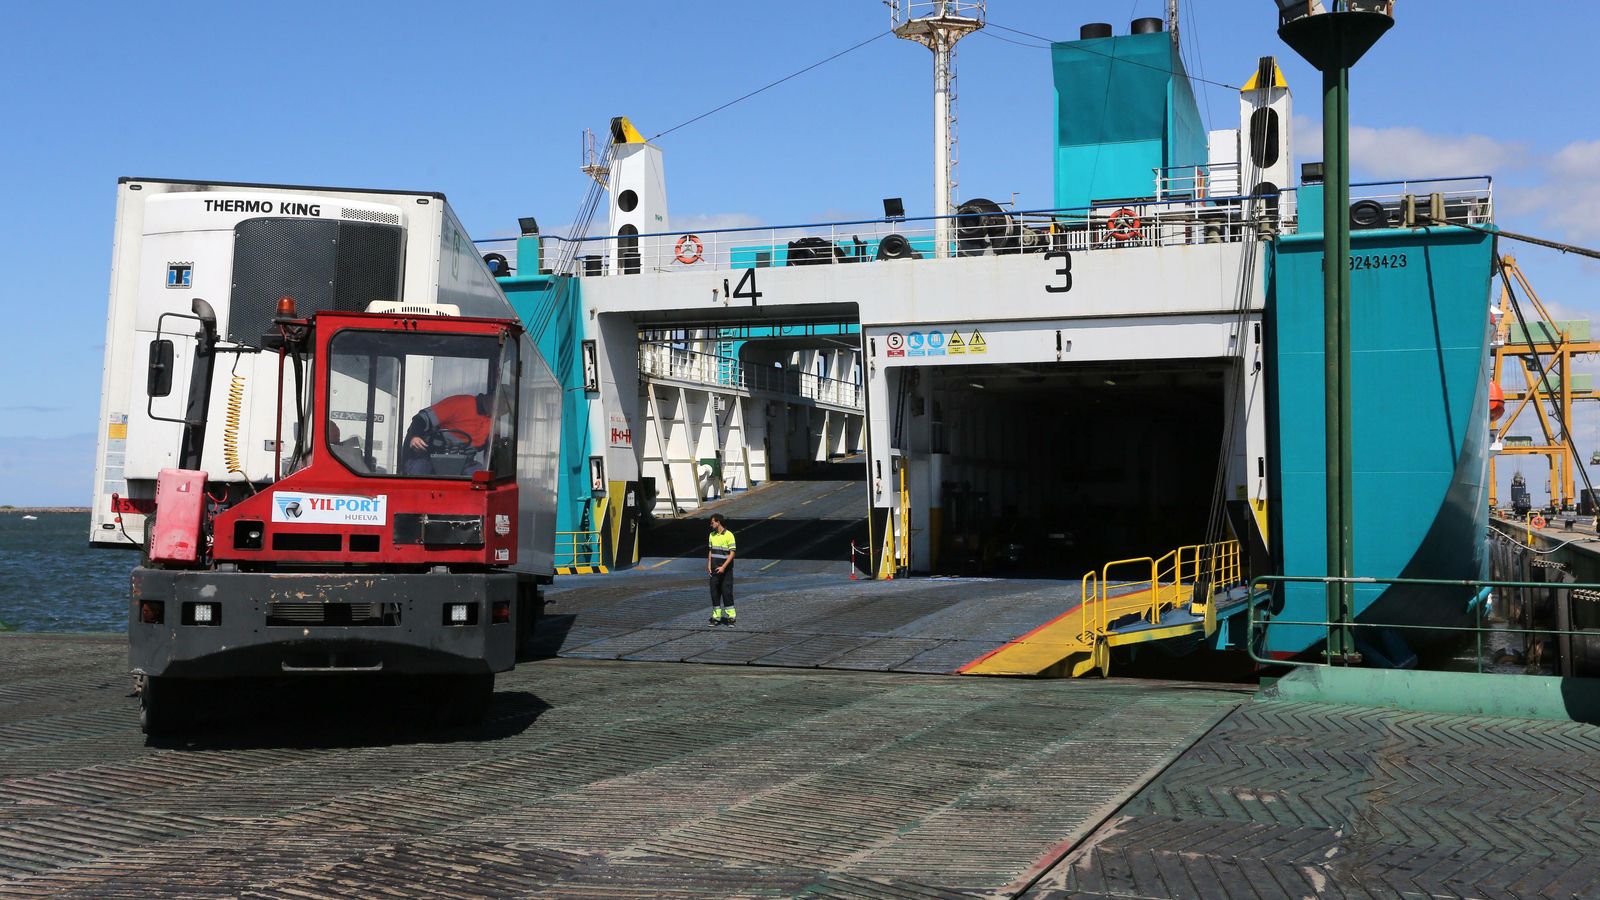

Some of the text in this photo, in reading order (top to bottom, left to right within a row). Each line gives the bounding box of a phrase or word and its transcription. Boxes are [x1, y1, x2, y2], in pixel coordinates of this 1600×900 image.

[204, 199, 321, 217] THERMO KING
[1044, 251, 1072, 293] 3
[732, 267, 763, 307] 4
[892, 336, 899, 346] 5
[309, 498, 381, 512] YILPORT
[344, 513, 378, 521] HUELVA
